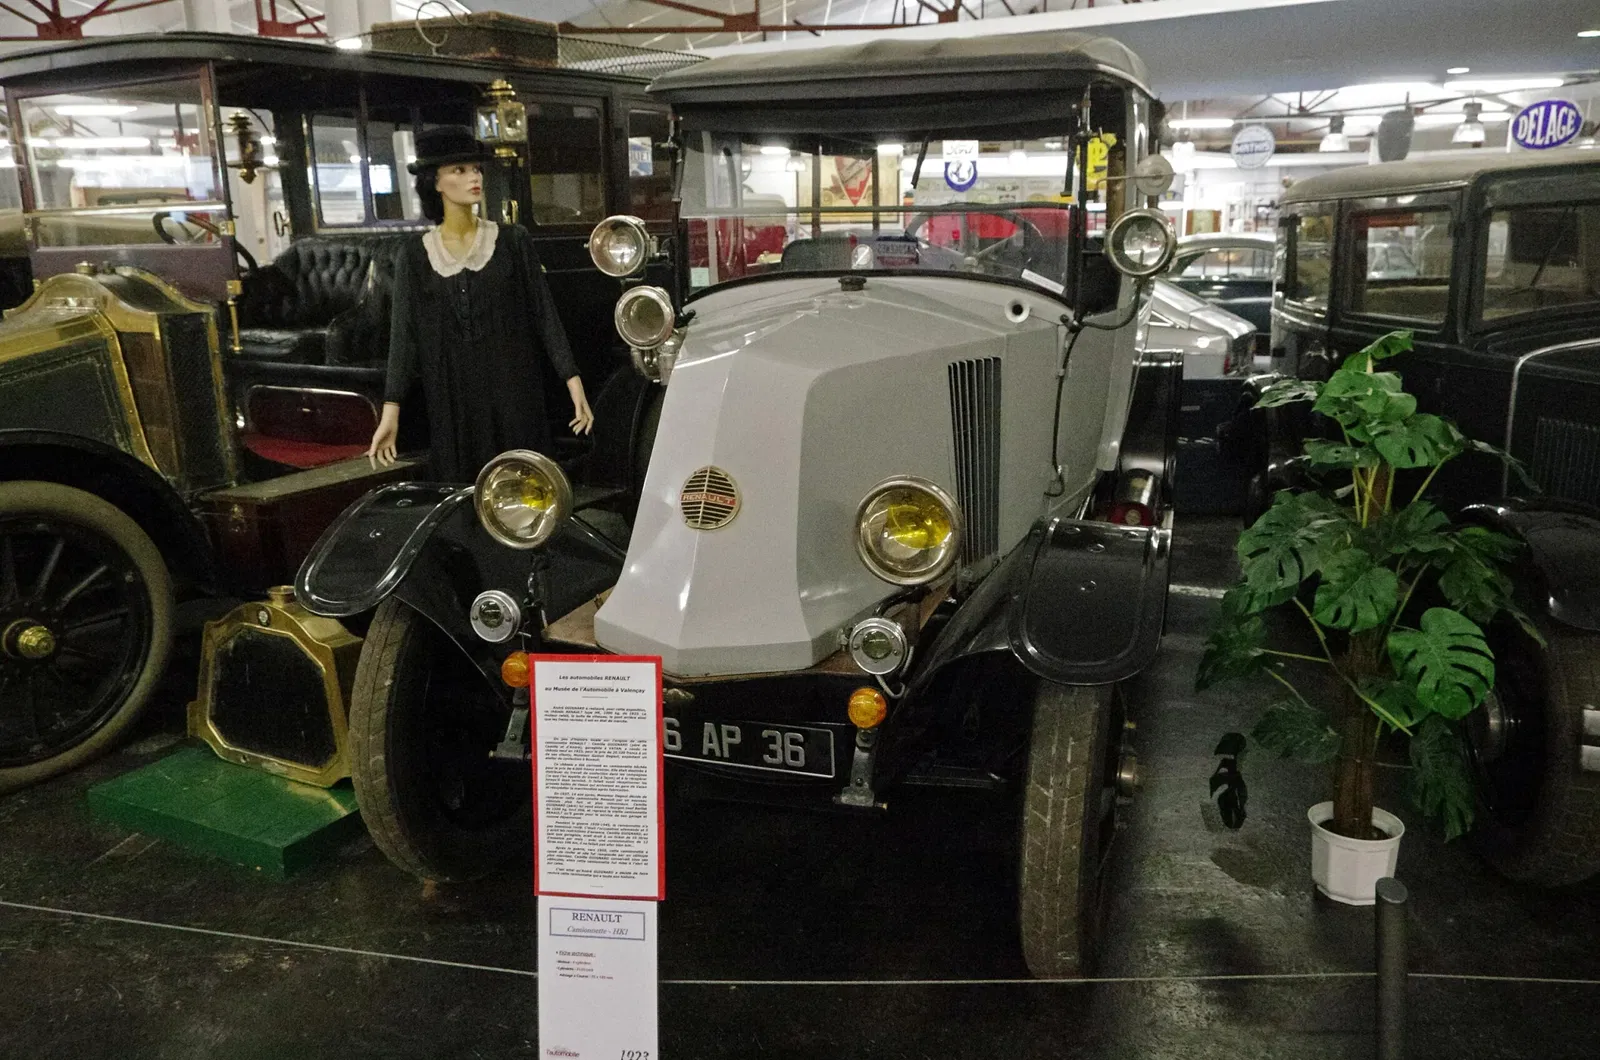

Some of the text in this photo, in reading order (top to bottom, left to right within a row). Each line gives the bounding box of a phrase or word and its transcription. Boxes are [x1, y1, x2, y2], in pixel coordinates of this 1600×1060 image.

[1517, 105, 1576, 145] DELAGE
[682, 494, 733, 504] RENAULT
[702, 722, 741, 758] AP
[762, 729, 805, 767] 36
[572, 912, 622, 923] RENAULT
[567, 926, 607, 934] Camionnette
